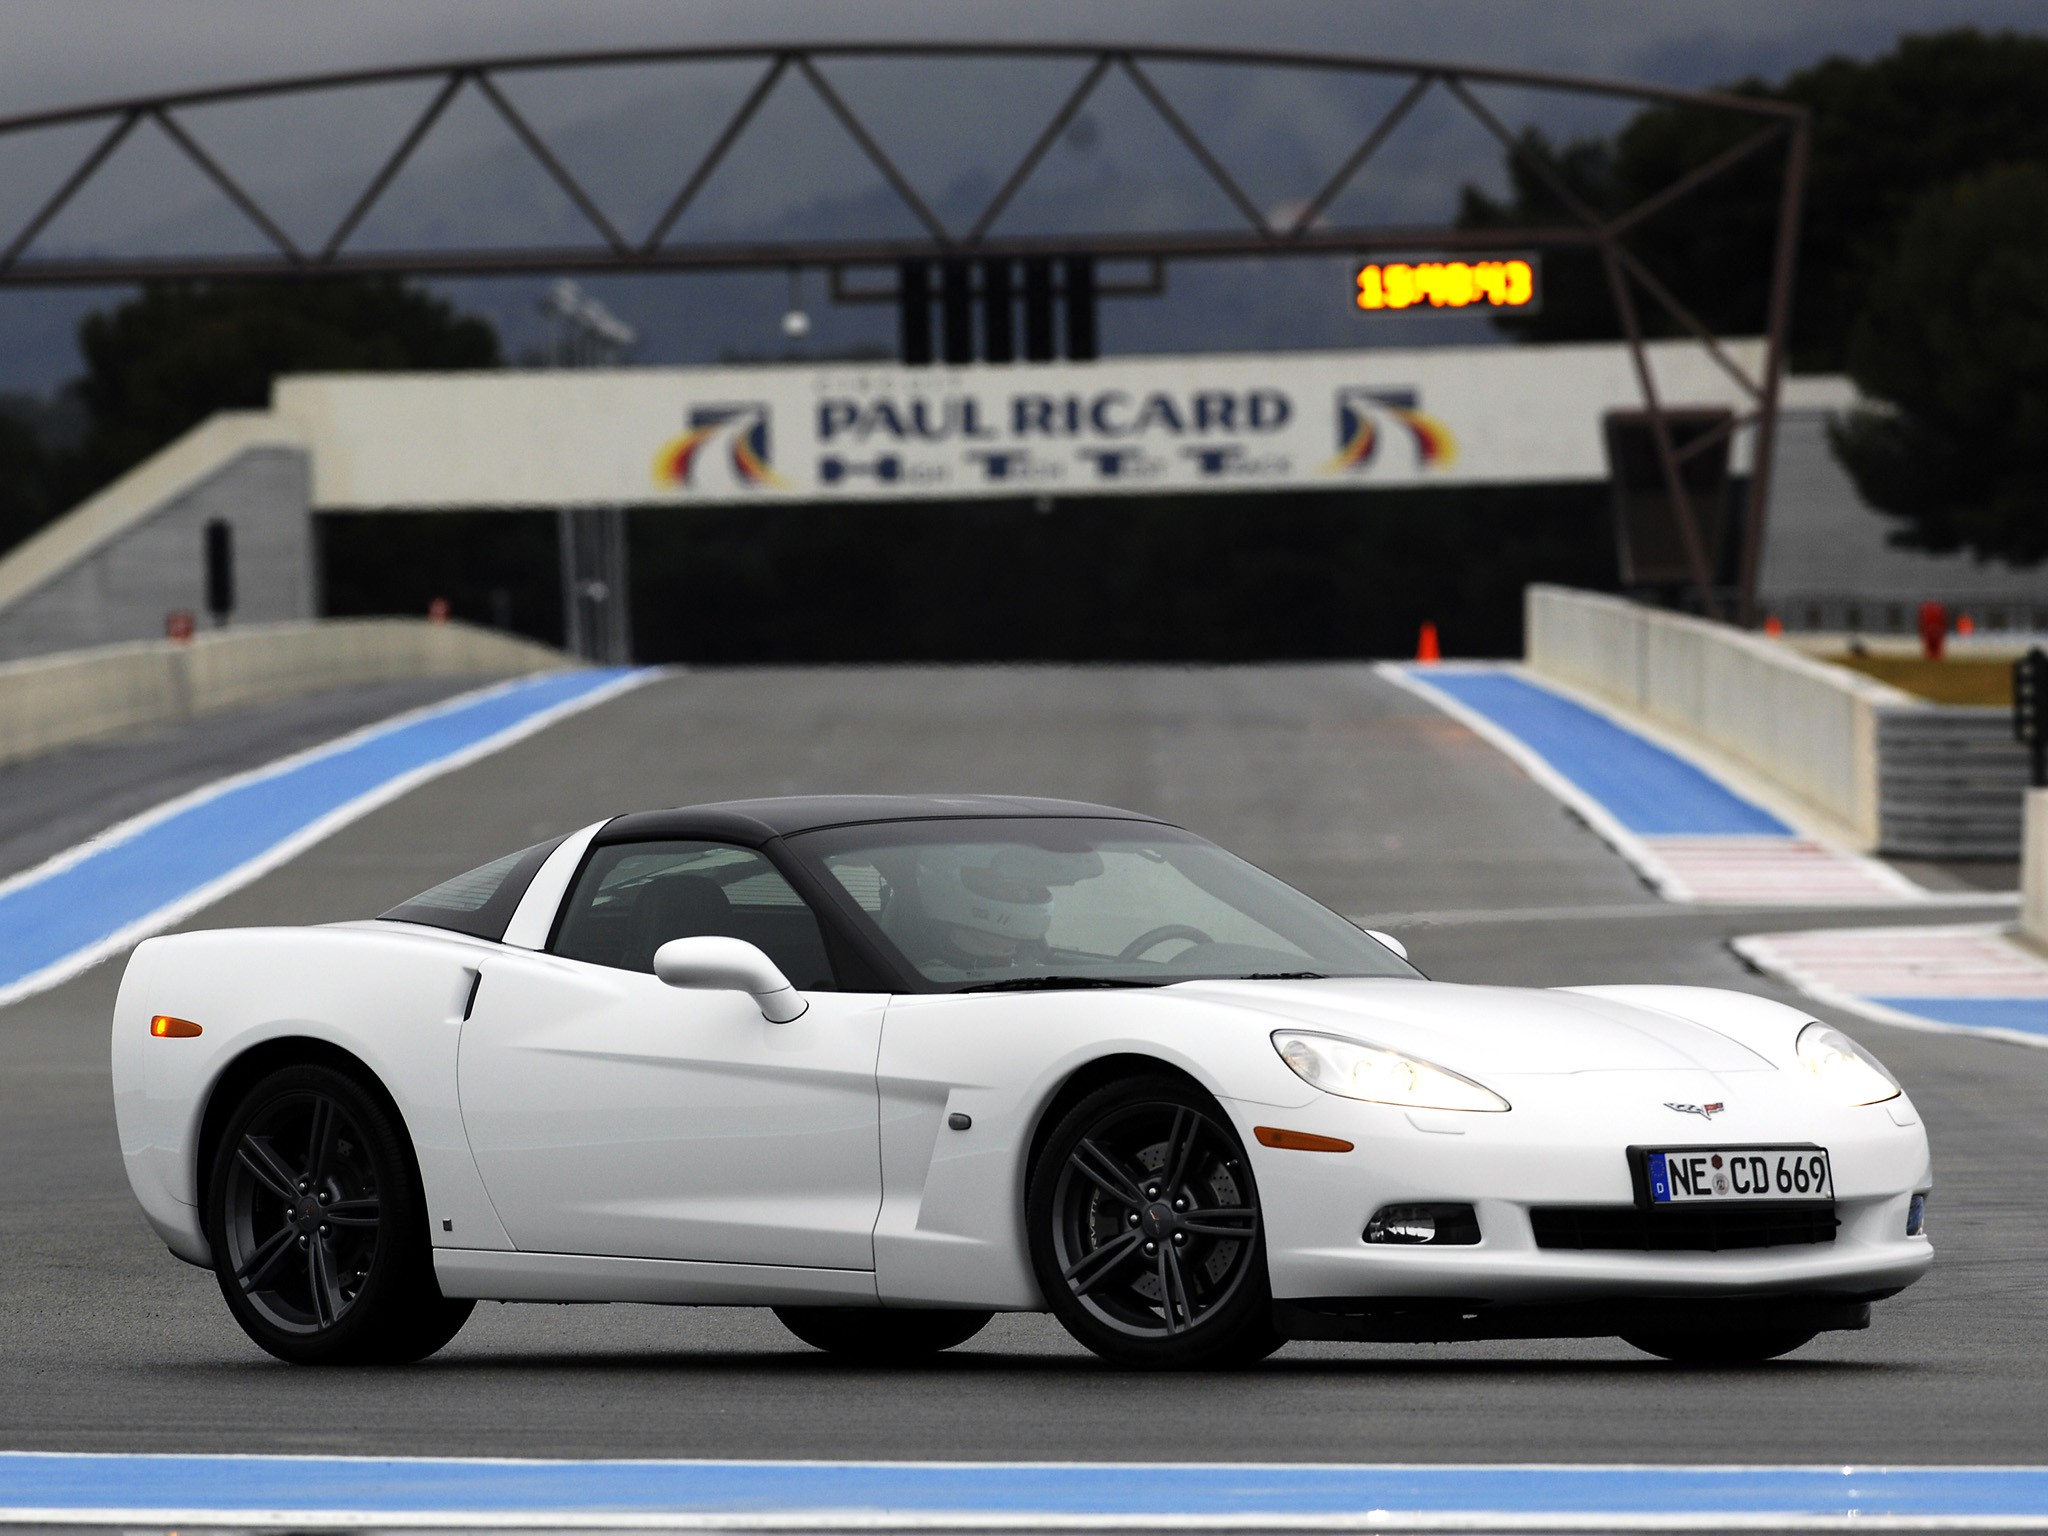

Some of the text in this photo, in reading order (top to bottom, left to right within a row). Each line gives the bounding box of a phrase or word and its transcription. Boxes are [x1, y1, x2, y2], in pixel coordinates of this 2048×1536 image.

[817, 389, 1294, 442] PAUL RICARD
[1656, 1182, 1665, 1194] D
[1668, 1156, 1826, 1196] NE CD 669
